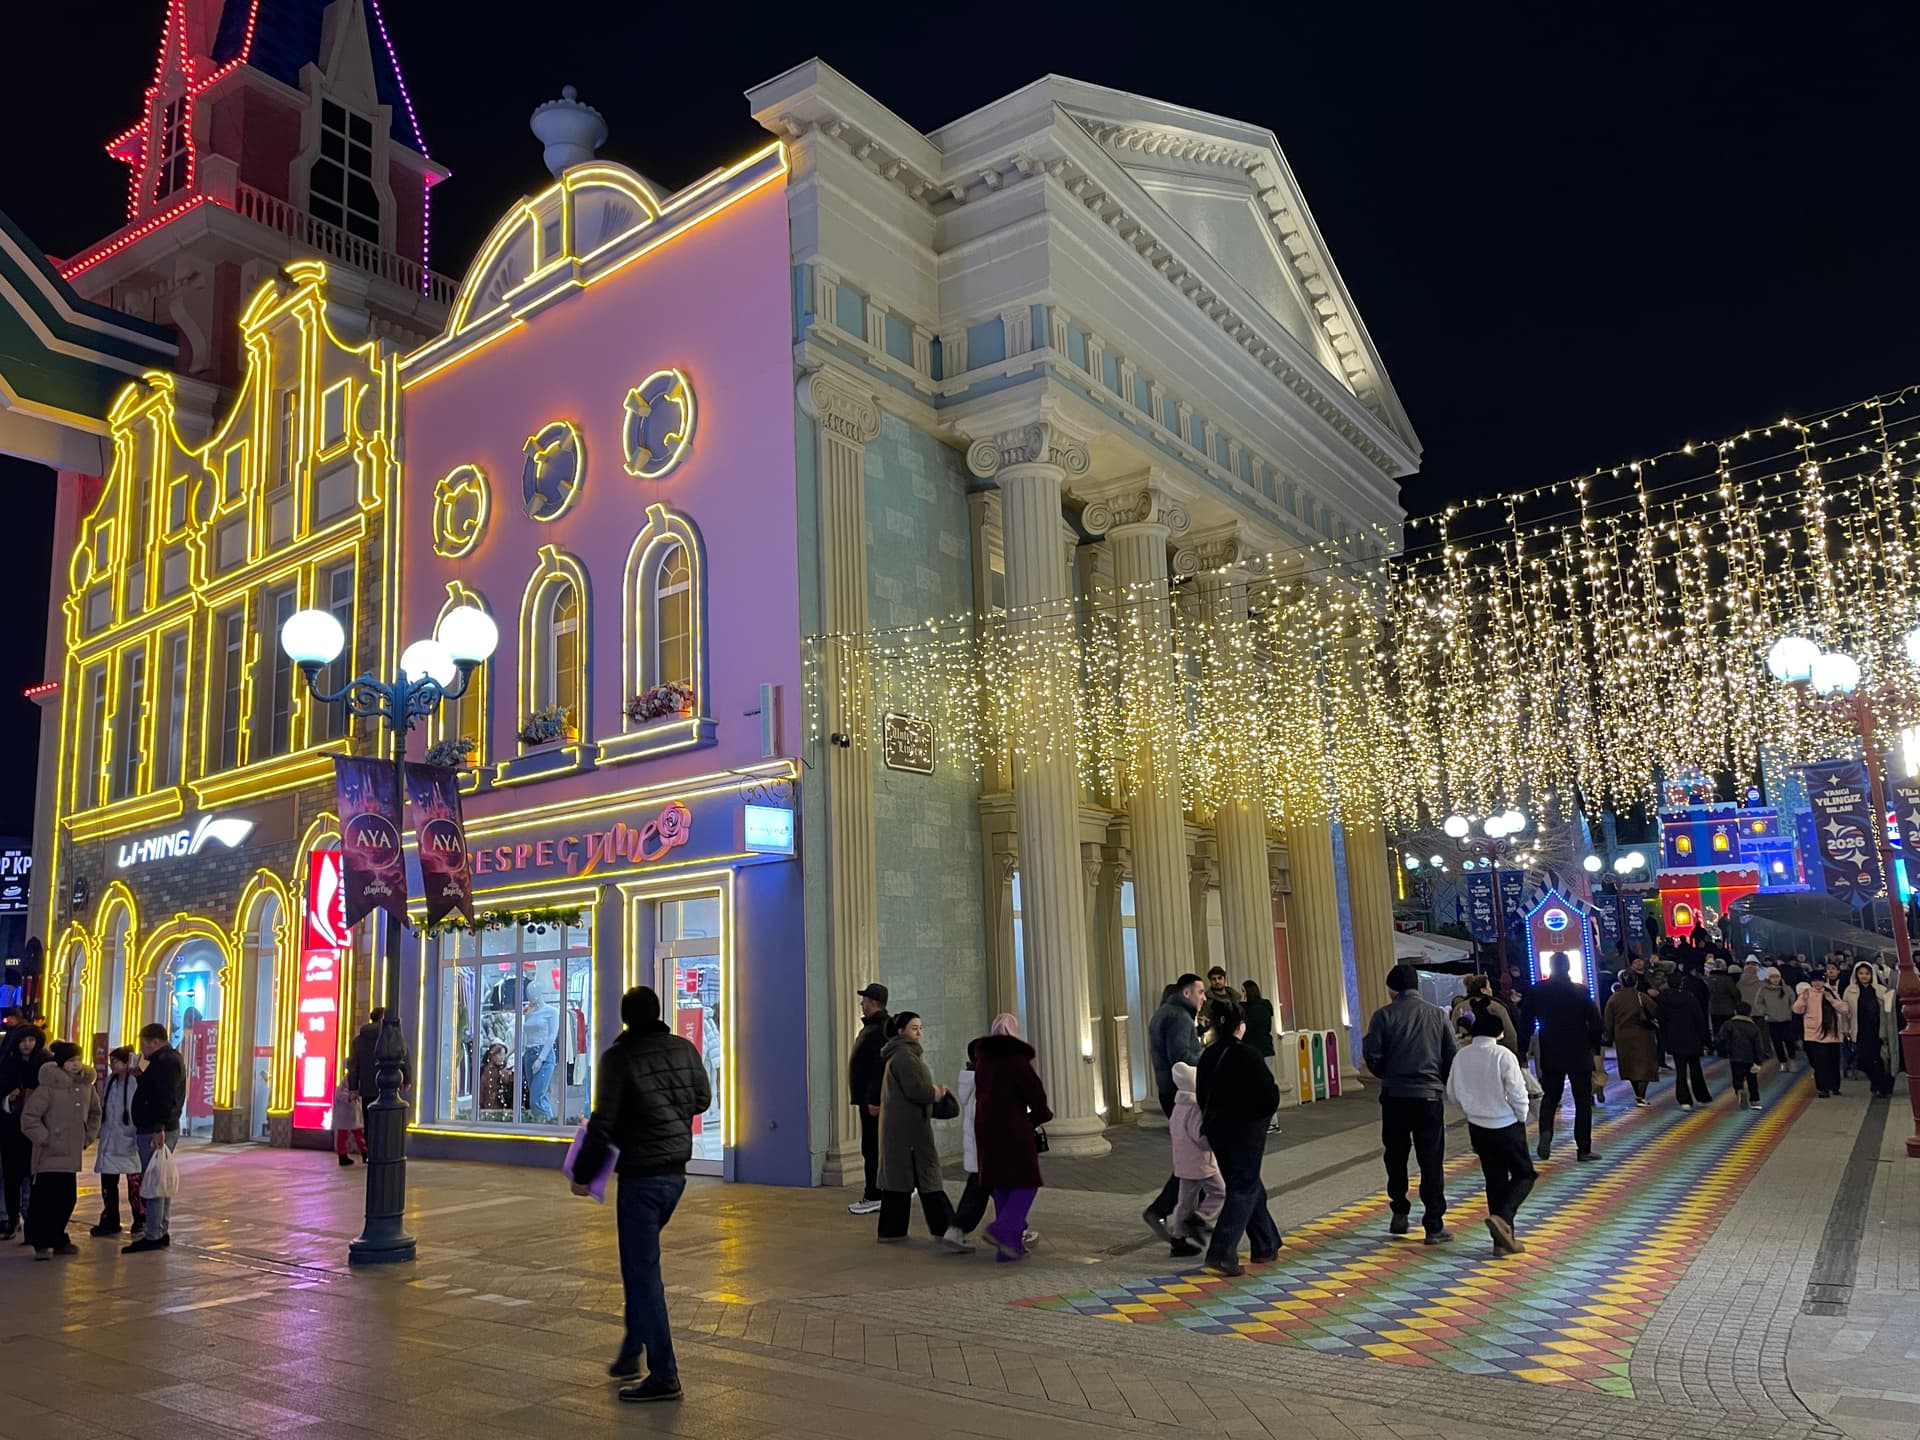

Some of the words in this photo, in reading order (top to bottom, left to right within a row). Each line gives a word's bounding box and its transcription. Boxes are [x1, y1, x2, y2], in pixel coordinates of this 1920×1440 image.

[1815, 794, 1862, 806] YILINGIZ
[117, 829, 190, 868] LI-NING
[356, 829, 392, 849] AYA
[432, 834, 461, 853] AYA
[1827, 837, 1866, 850] 2026
